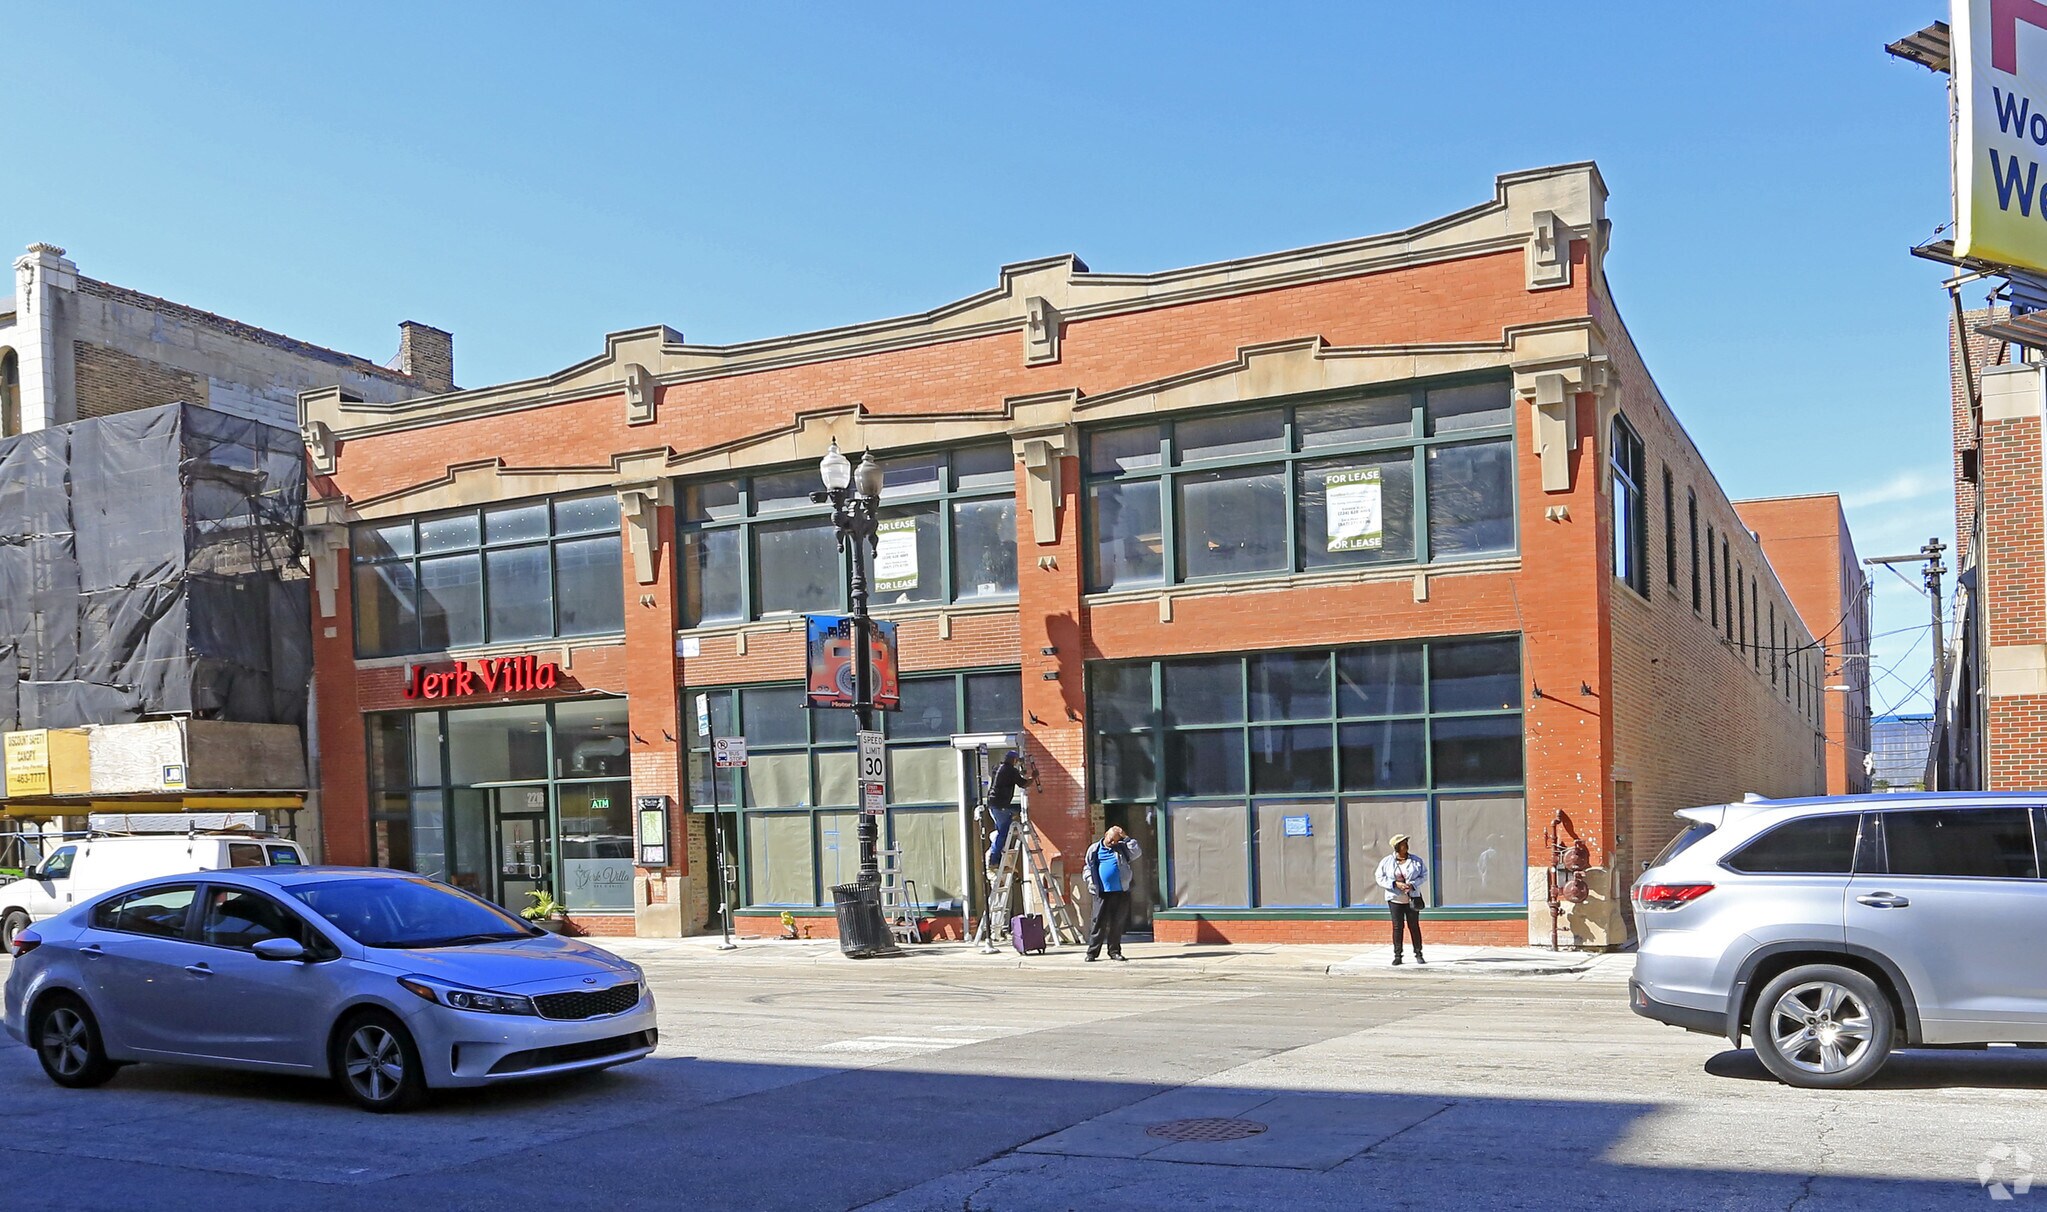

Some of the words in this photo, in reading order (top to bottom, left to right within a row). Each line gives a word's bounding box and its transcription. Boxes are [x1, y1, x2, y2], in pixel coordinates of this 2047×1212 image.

[1326, 474, 1347, 484] FOR
[1348, 471, 1379, 482] LEASE
[877, 523, 890, 531] OR
[890, 520, 915, 530] LEASE
[1350, 538, 1381, 548] LEASE
[875, 582, 892, 591] FOR
[893, 579, 917, 589] LEASE
[403, 661, 477, 699] Jerk
[478, 655, 559, 693] Villa
[8, 735, 28, 746] DISCOUNT
[29, 733, 45, 745] SAFETY
[863, 735, 882, 744] SPEED
[866, 747, 881, 755] LIMIT
[865, 757, 882, 775] 30
[592, 799, 609, 809] ATM
